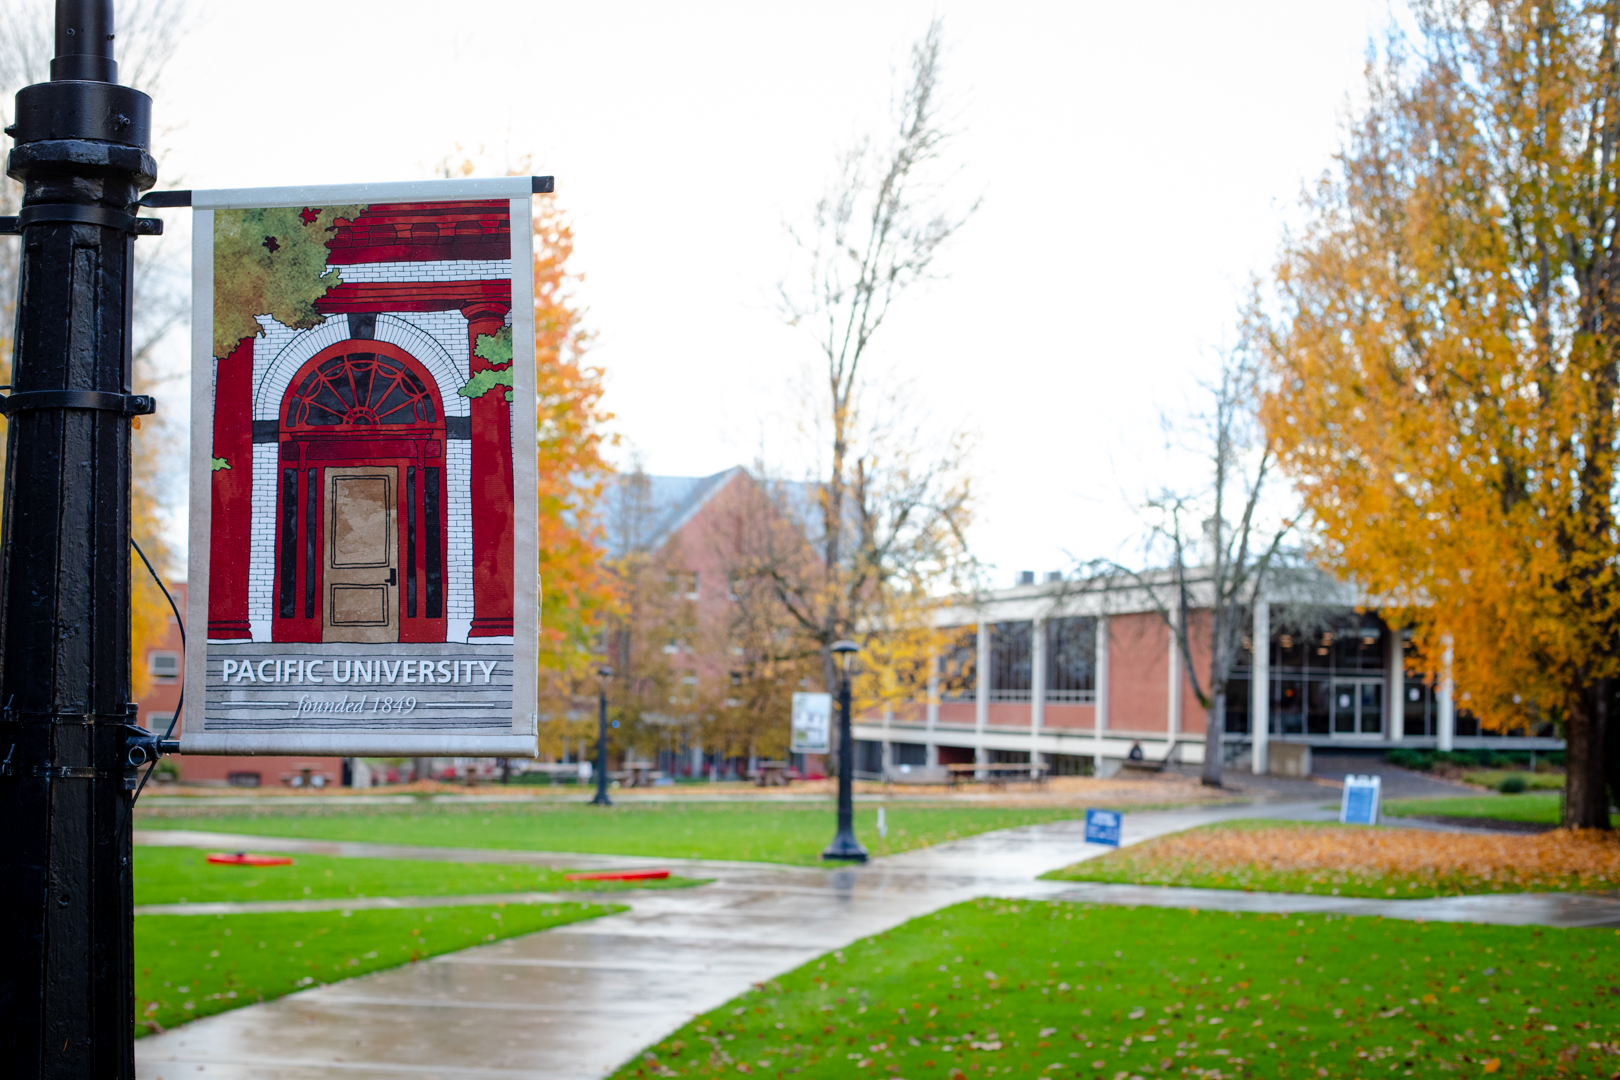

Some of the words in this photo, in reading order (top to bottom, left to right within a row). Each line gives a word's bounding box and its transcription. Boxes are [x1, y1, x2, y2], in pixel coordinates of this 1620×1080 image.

[222, 659, 324, 683] PACIFIC
[333, 659, 497, 683] UNIVERSITY
[294, 695, 365, 717] founded
[372, 696, 417, 714] 1849
